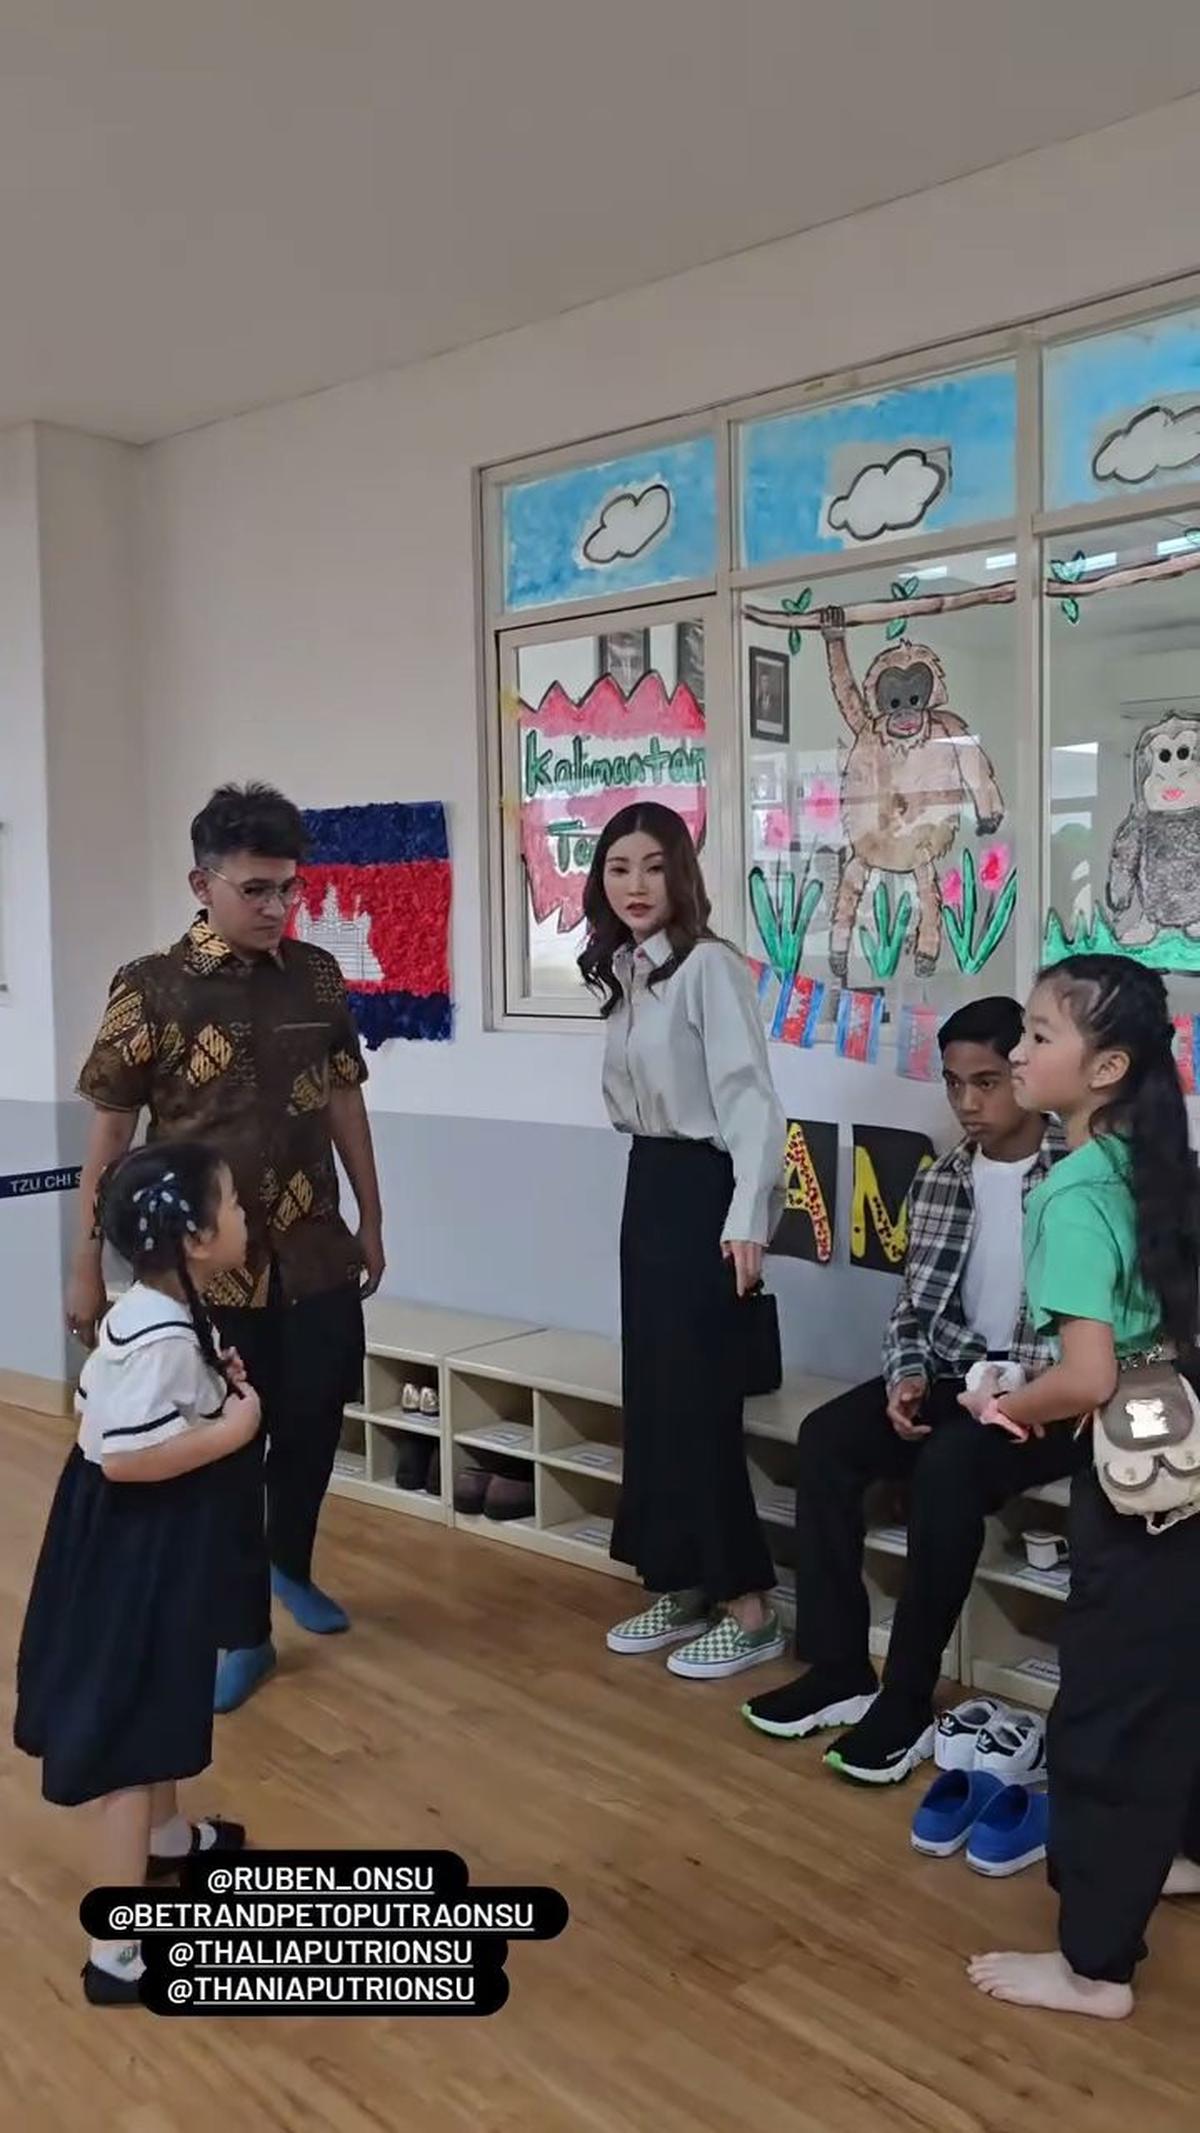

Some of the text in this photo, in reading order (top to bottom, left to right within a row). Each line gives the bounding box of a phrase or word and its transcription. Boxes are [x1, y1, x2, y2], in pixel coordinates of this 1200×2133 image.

[544, 820, 594, 872] Te
[10, 1177, 41, 1194] TZU
[44, 1172, 71, 1189] CHI
